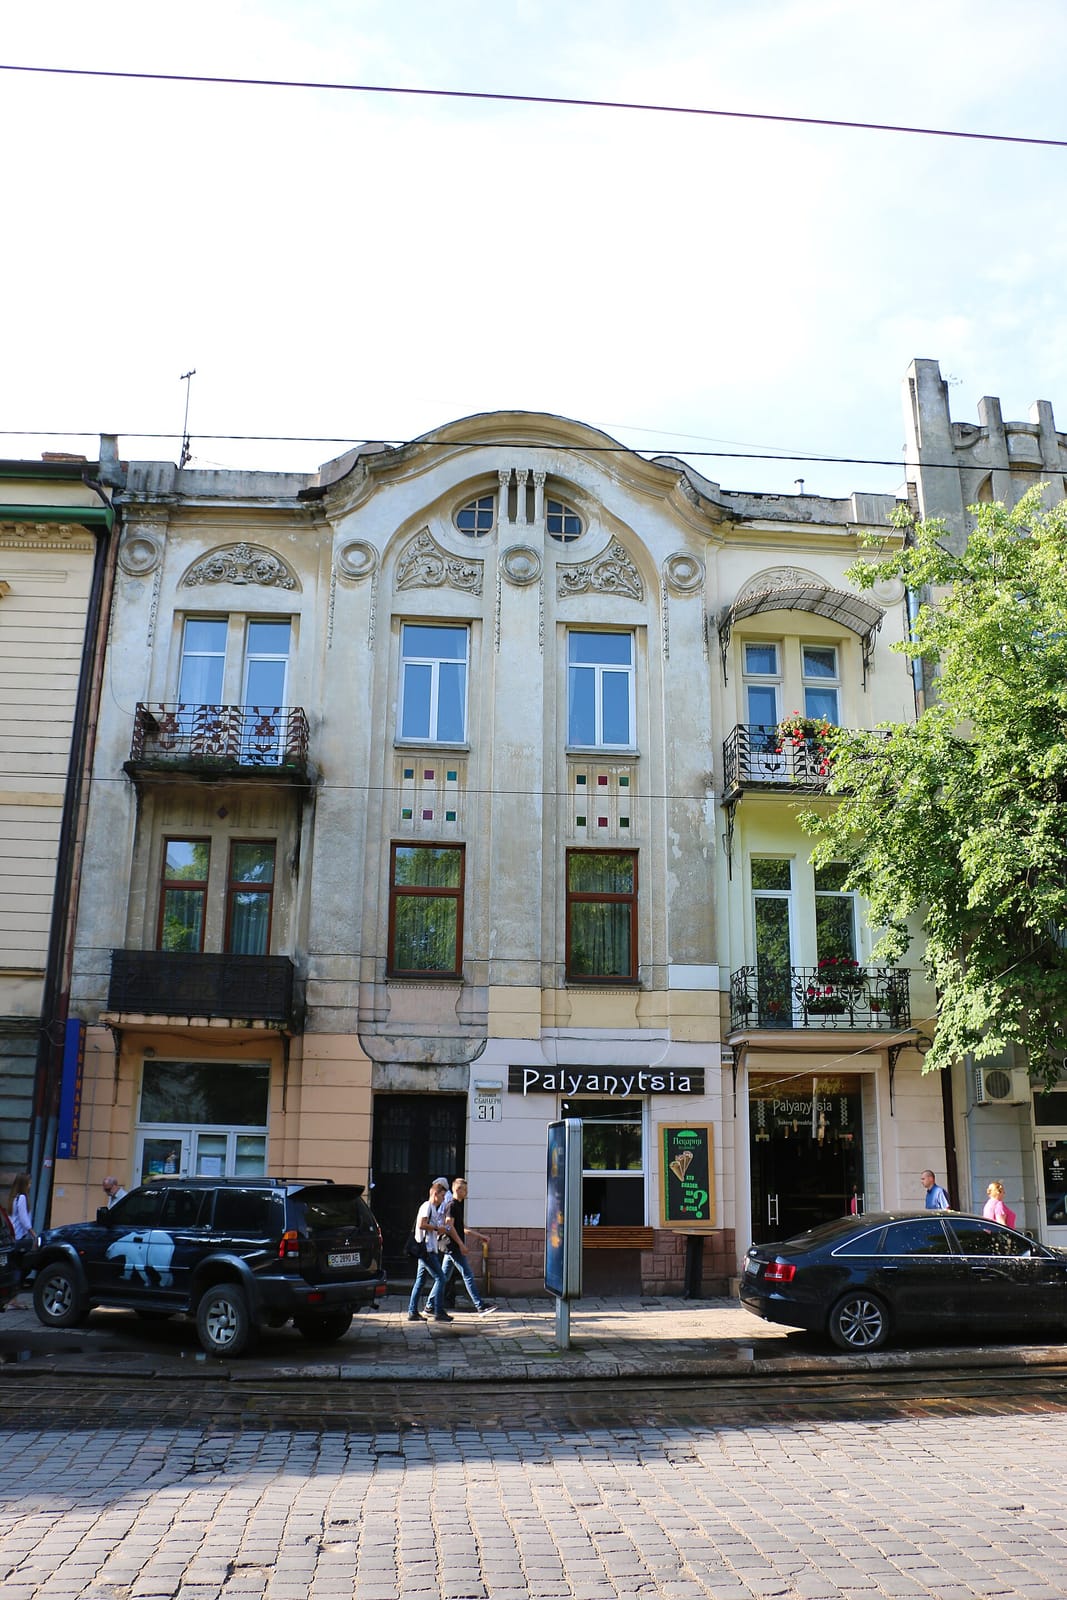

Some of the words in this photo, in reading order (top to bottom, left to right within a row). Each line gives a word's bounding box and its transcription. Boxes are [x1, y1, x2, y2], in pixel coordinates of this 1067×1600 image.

[523, 1068, 692, 1097] Palyanytsia
[478, 1105, 495, 1120] 31
[773, 1098, 832, 1116] Palyanysia
